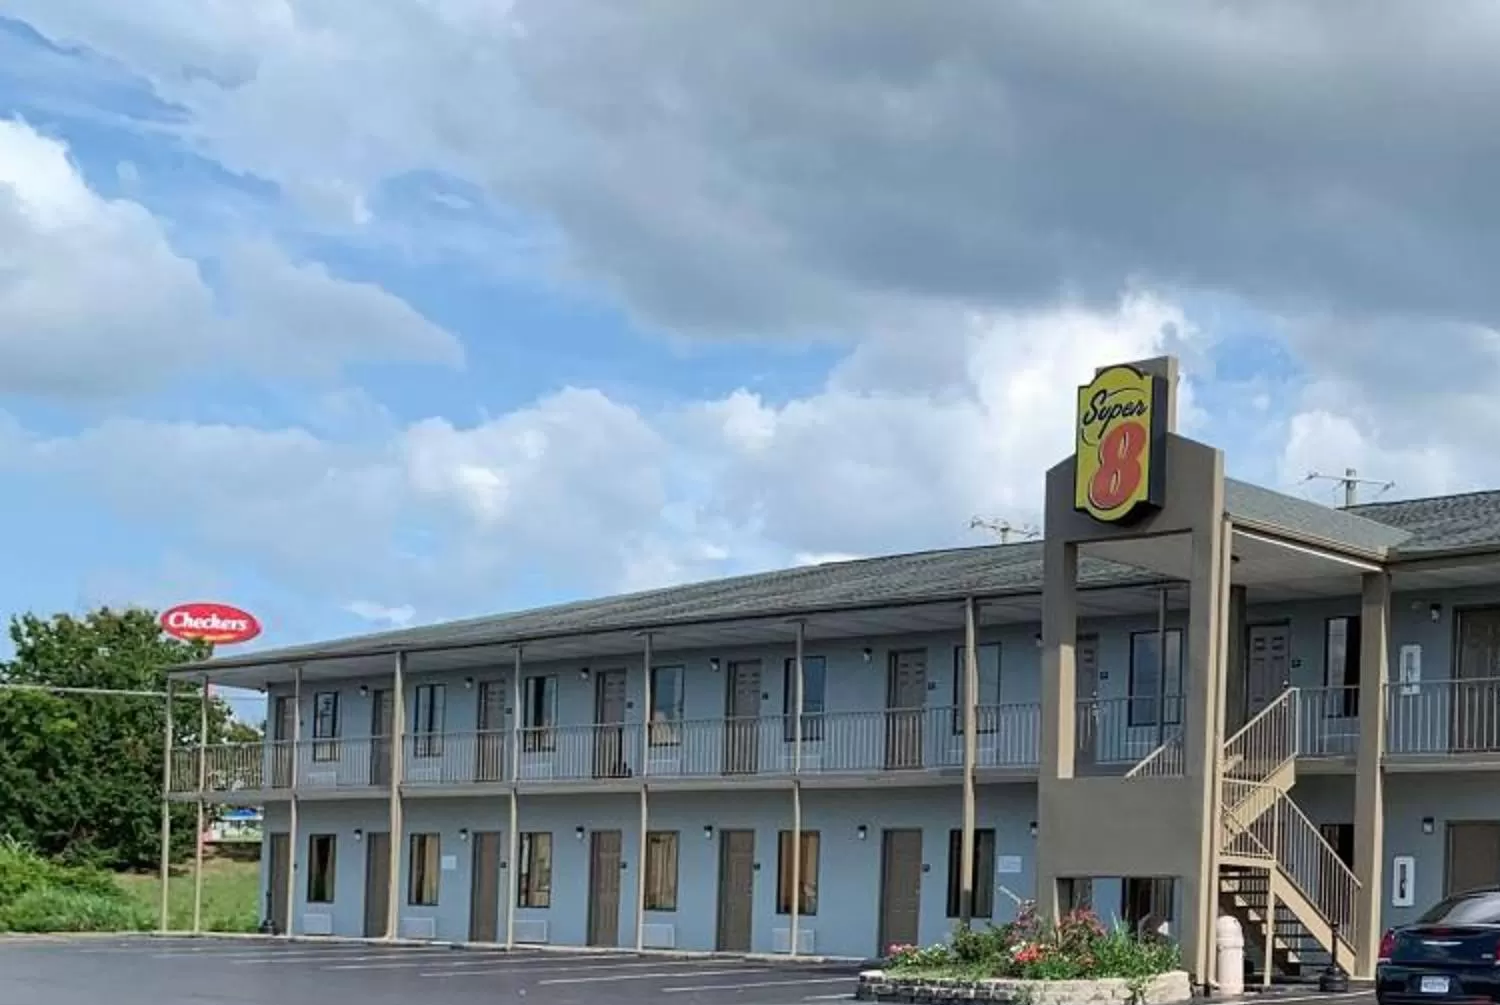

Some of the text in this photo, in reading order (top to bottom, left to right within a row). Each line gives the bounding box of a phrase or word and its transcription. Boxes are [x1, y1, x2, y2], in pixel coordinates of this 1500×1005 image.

[1083, 389, 1148, 439] Super
[1089, 422, 1147, 510] 8
[168, 611, 247, 631] Checkers
